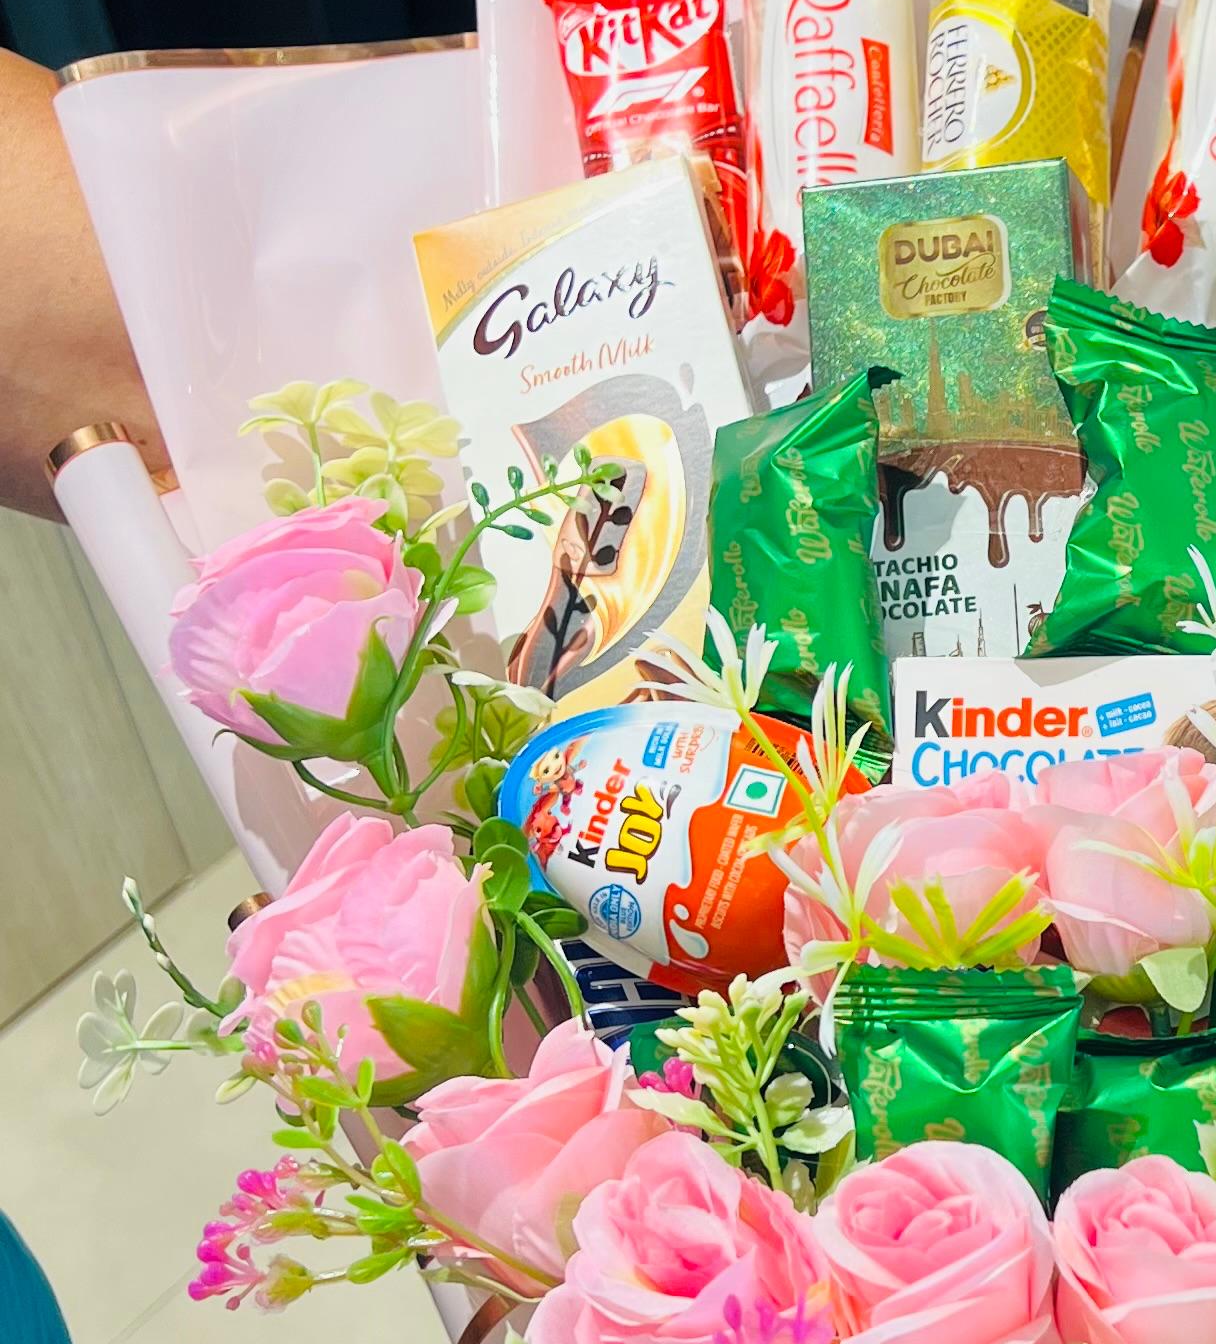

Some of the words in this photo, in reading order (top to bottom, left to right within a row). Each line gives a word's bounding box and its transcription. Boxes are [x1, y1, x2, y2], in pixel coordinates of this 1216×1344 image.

[926, 31, 946, 155] ROCHER
[943, 24, 968, 144] FERRERO
[893, 252, 997, 301] Chocolate
[894, 230, 994, 266] DUBAI
[472, 255, 676, 360] Galaxy
[924, 290, 967, 307] FACTORY
[519, 351, 594, 395] Smooth
[598, 333, 655, 371] Milk
[882, 596, 978, 621] COLATE
[604, 777, 663, 885] JOY
